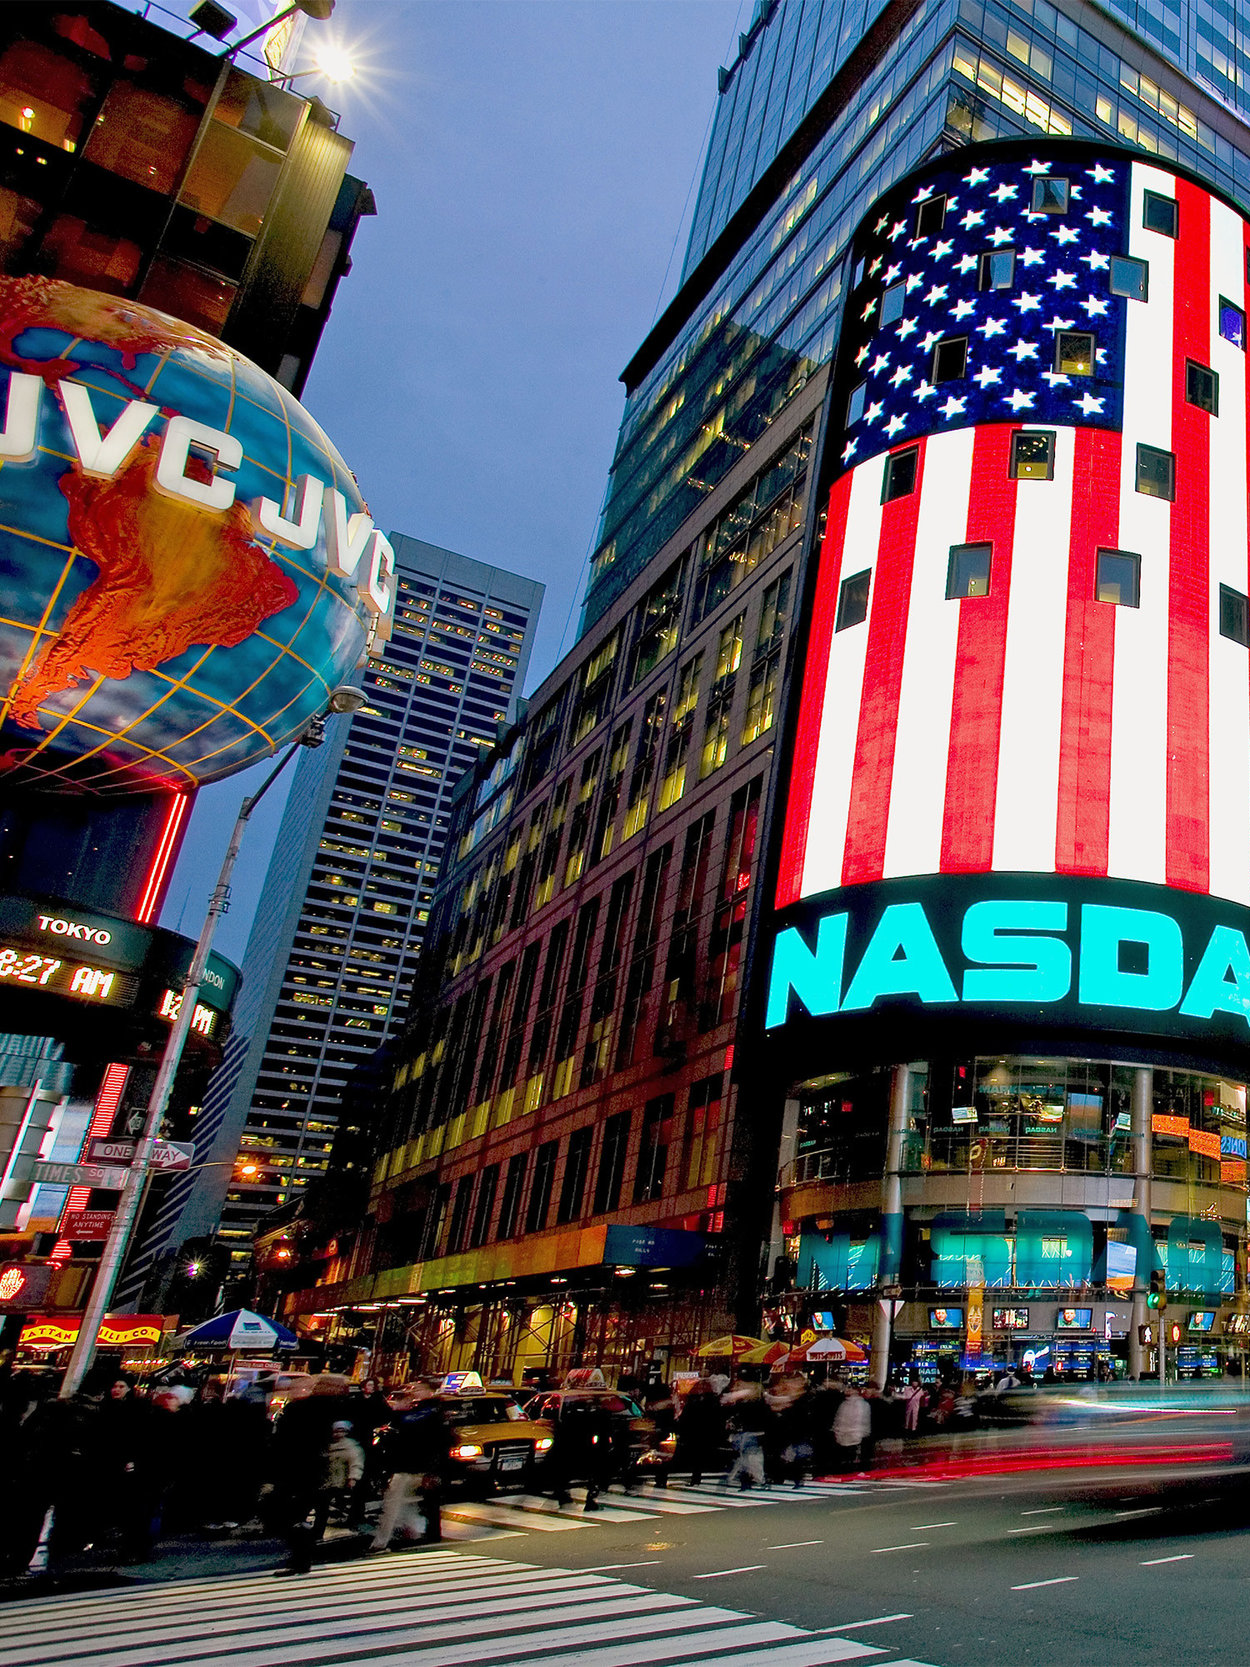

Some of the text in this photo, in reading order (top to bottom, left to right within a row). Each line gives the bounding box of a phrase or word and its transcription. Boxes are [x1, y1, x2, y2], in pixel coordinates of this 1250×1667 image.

[0, 371, 243, 513] JVC
[251, 472, 395, 615] JVC
[38, 915, 112, 945] TOKYO
[69, 966, 115, 998] AM
[191, 1004, 215, 1035] PM
[104, 1144, 180, 1162] ONE WAY
[33, 1164, 83, 1184] TIMES
[82, 1213, 112, 1221] STANDING
